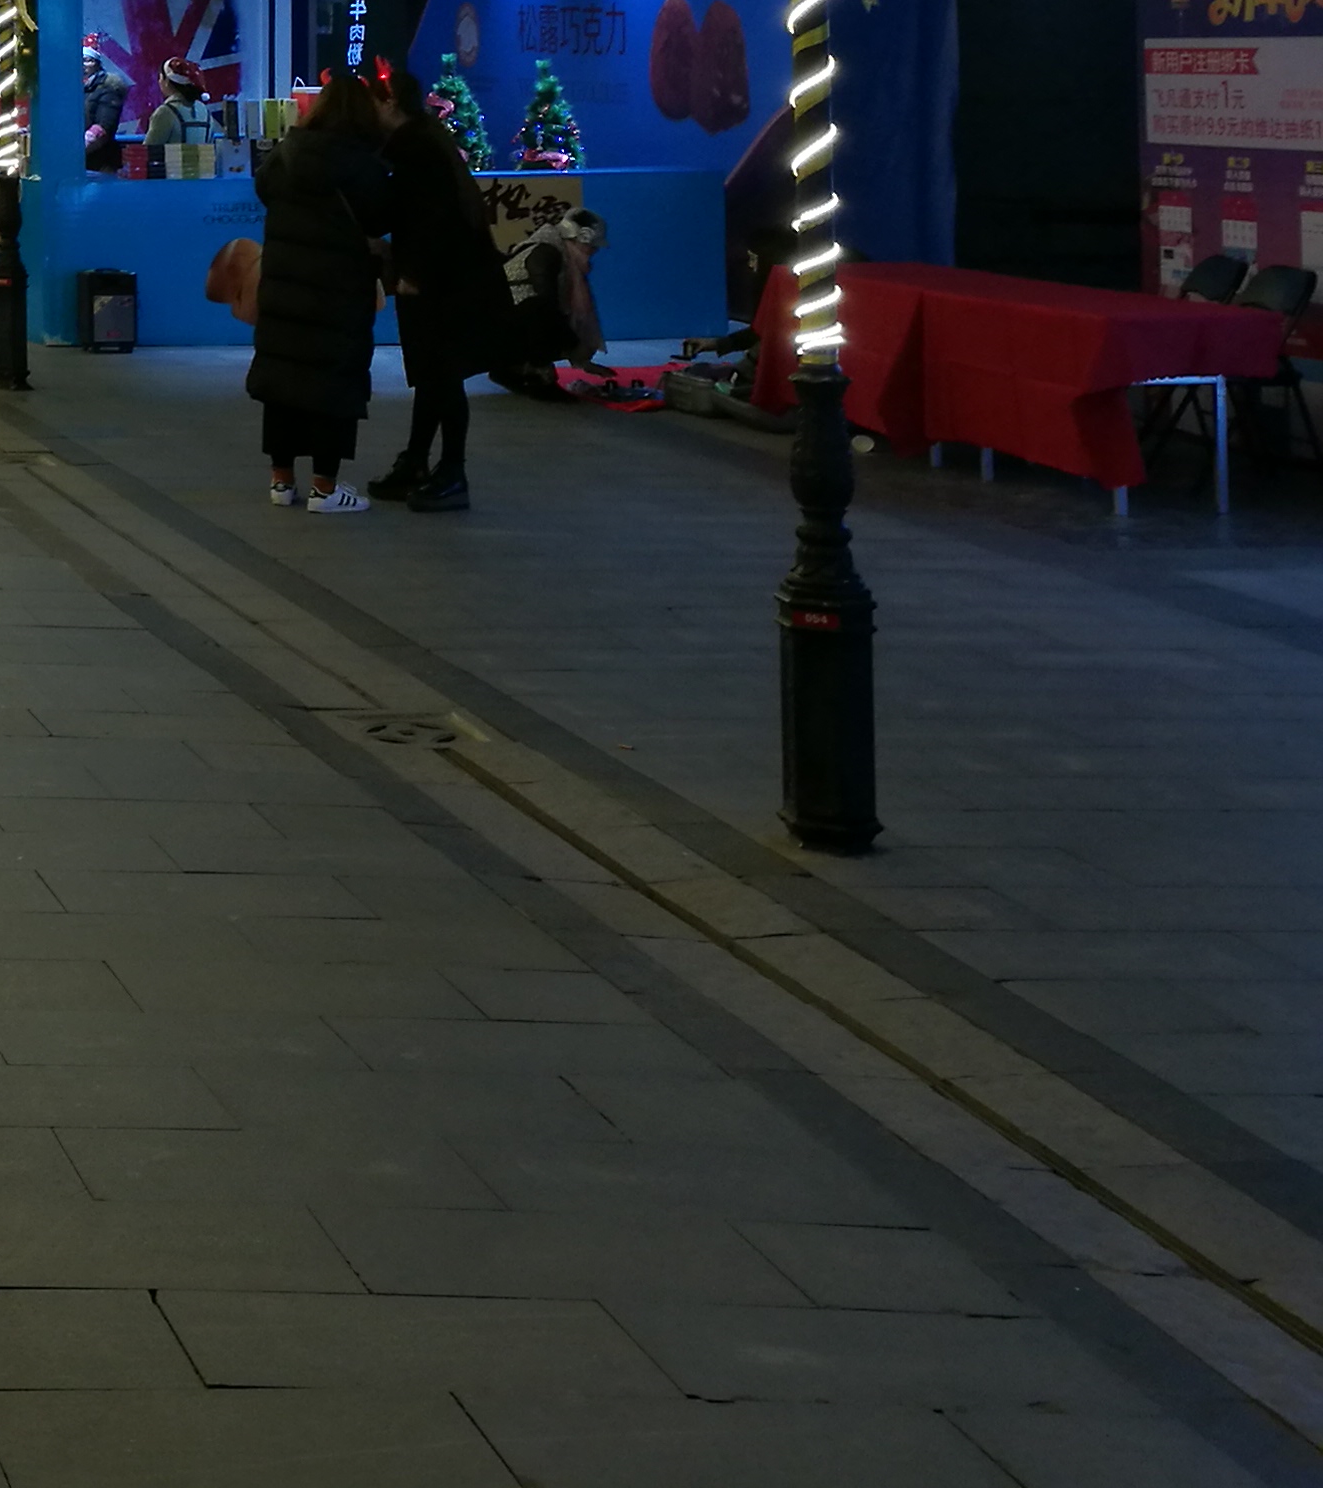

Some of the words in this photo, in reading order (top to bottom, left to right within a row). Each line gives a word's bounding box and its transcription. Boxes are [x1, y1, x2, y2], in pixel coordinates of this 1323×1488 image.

[518, 2, 626, 55] 松露巧克力
